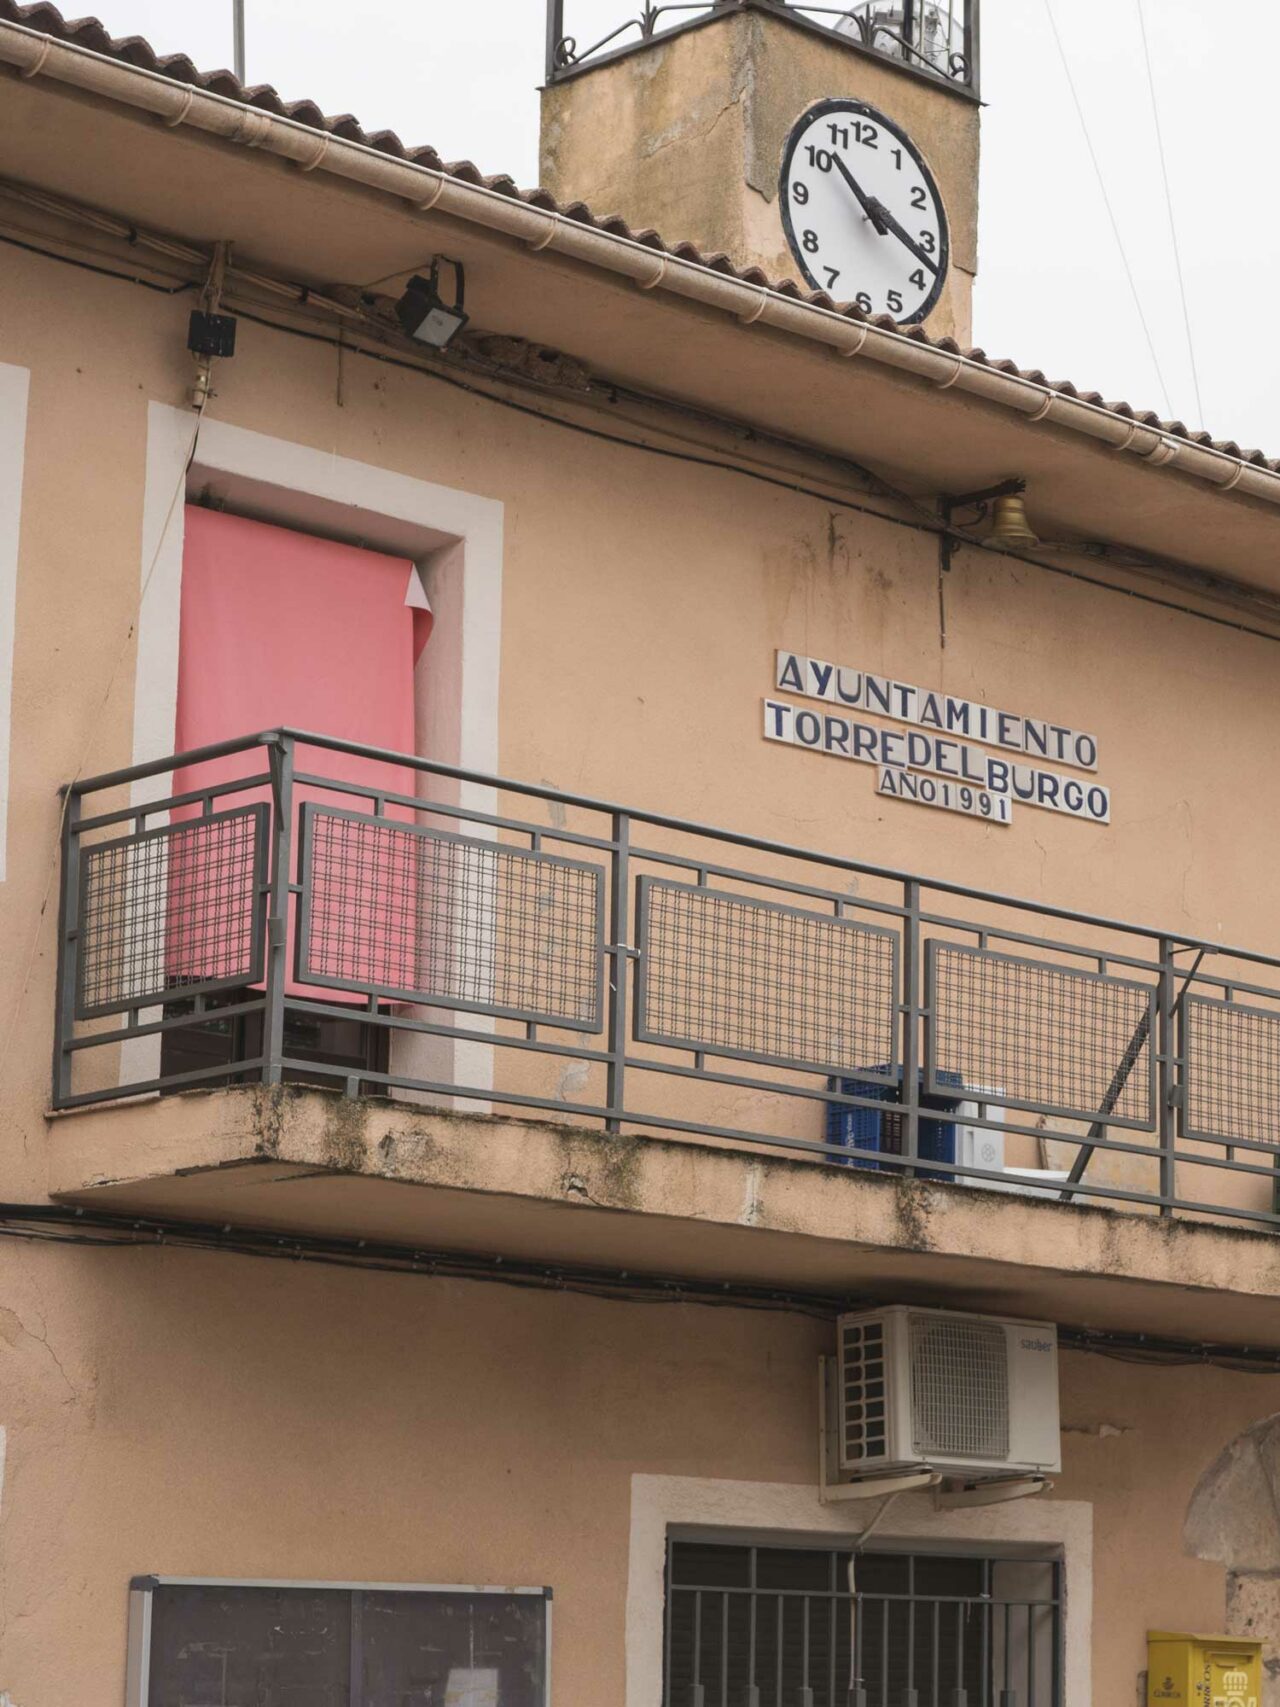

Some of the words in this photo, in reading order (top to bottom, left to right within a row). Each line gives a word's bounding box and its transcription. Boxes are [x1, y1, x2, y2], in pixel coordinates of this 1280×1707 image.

[827, 123, 848, 149] 11
[850, 121, 878, 149] 12
[804, 145, 832, 172] 10
[890, 149, 901, 170] 1
[792, 181, 809, 205] 9
[910, 186, 926, 210] 2
[802, 229, 818, 253] 8
[918, 230, 935, 253] 3
[823, 266, 840, 289] 7
[909, 269, 926, 290] 4
[855, 292, 872, 314] 6
[886, 290, 903, 312] 5
[778, 654, 1097, 767] AYUNTAMIENTO
